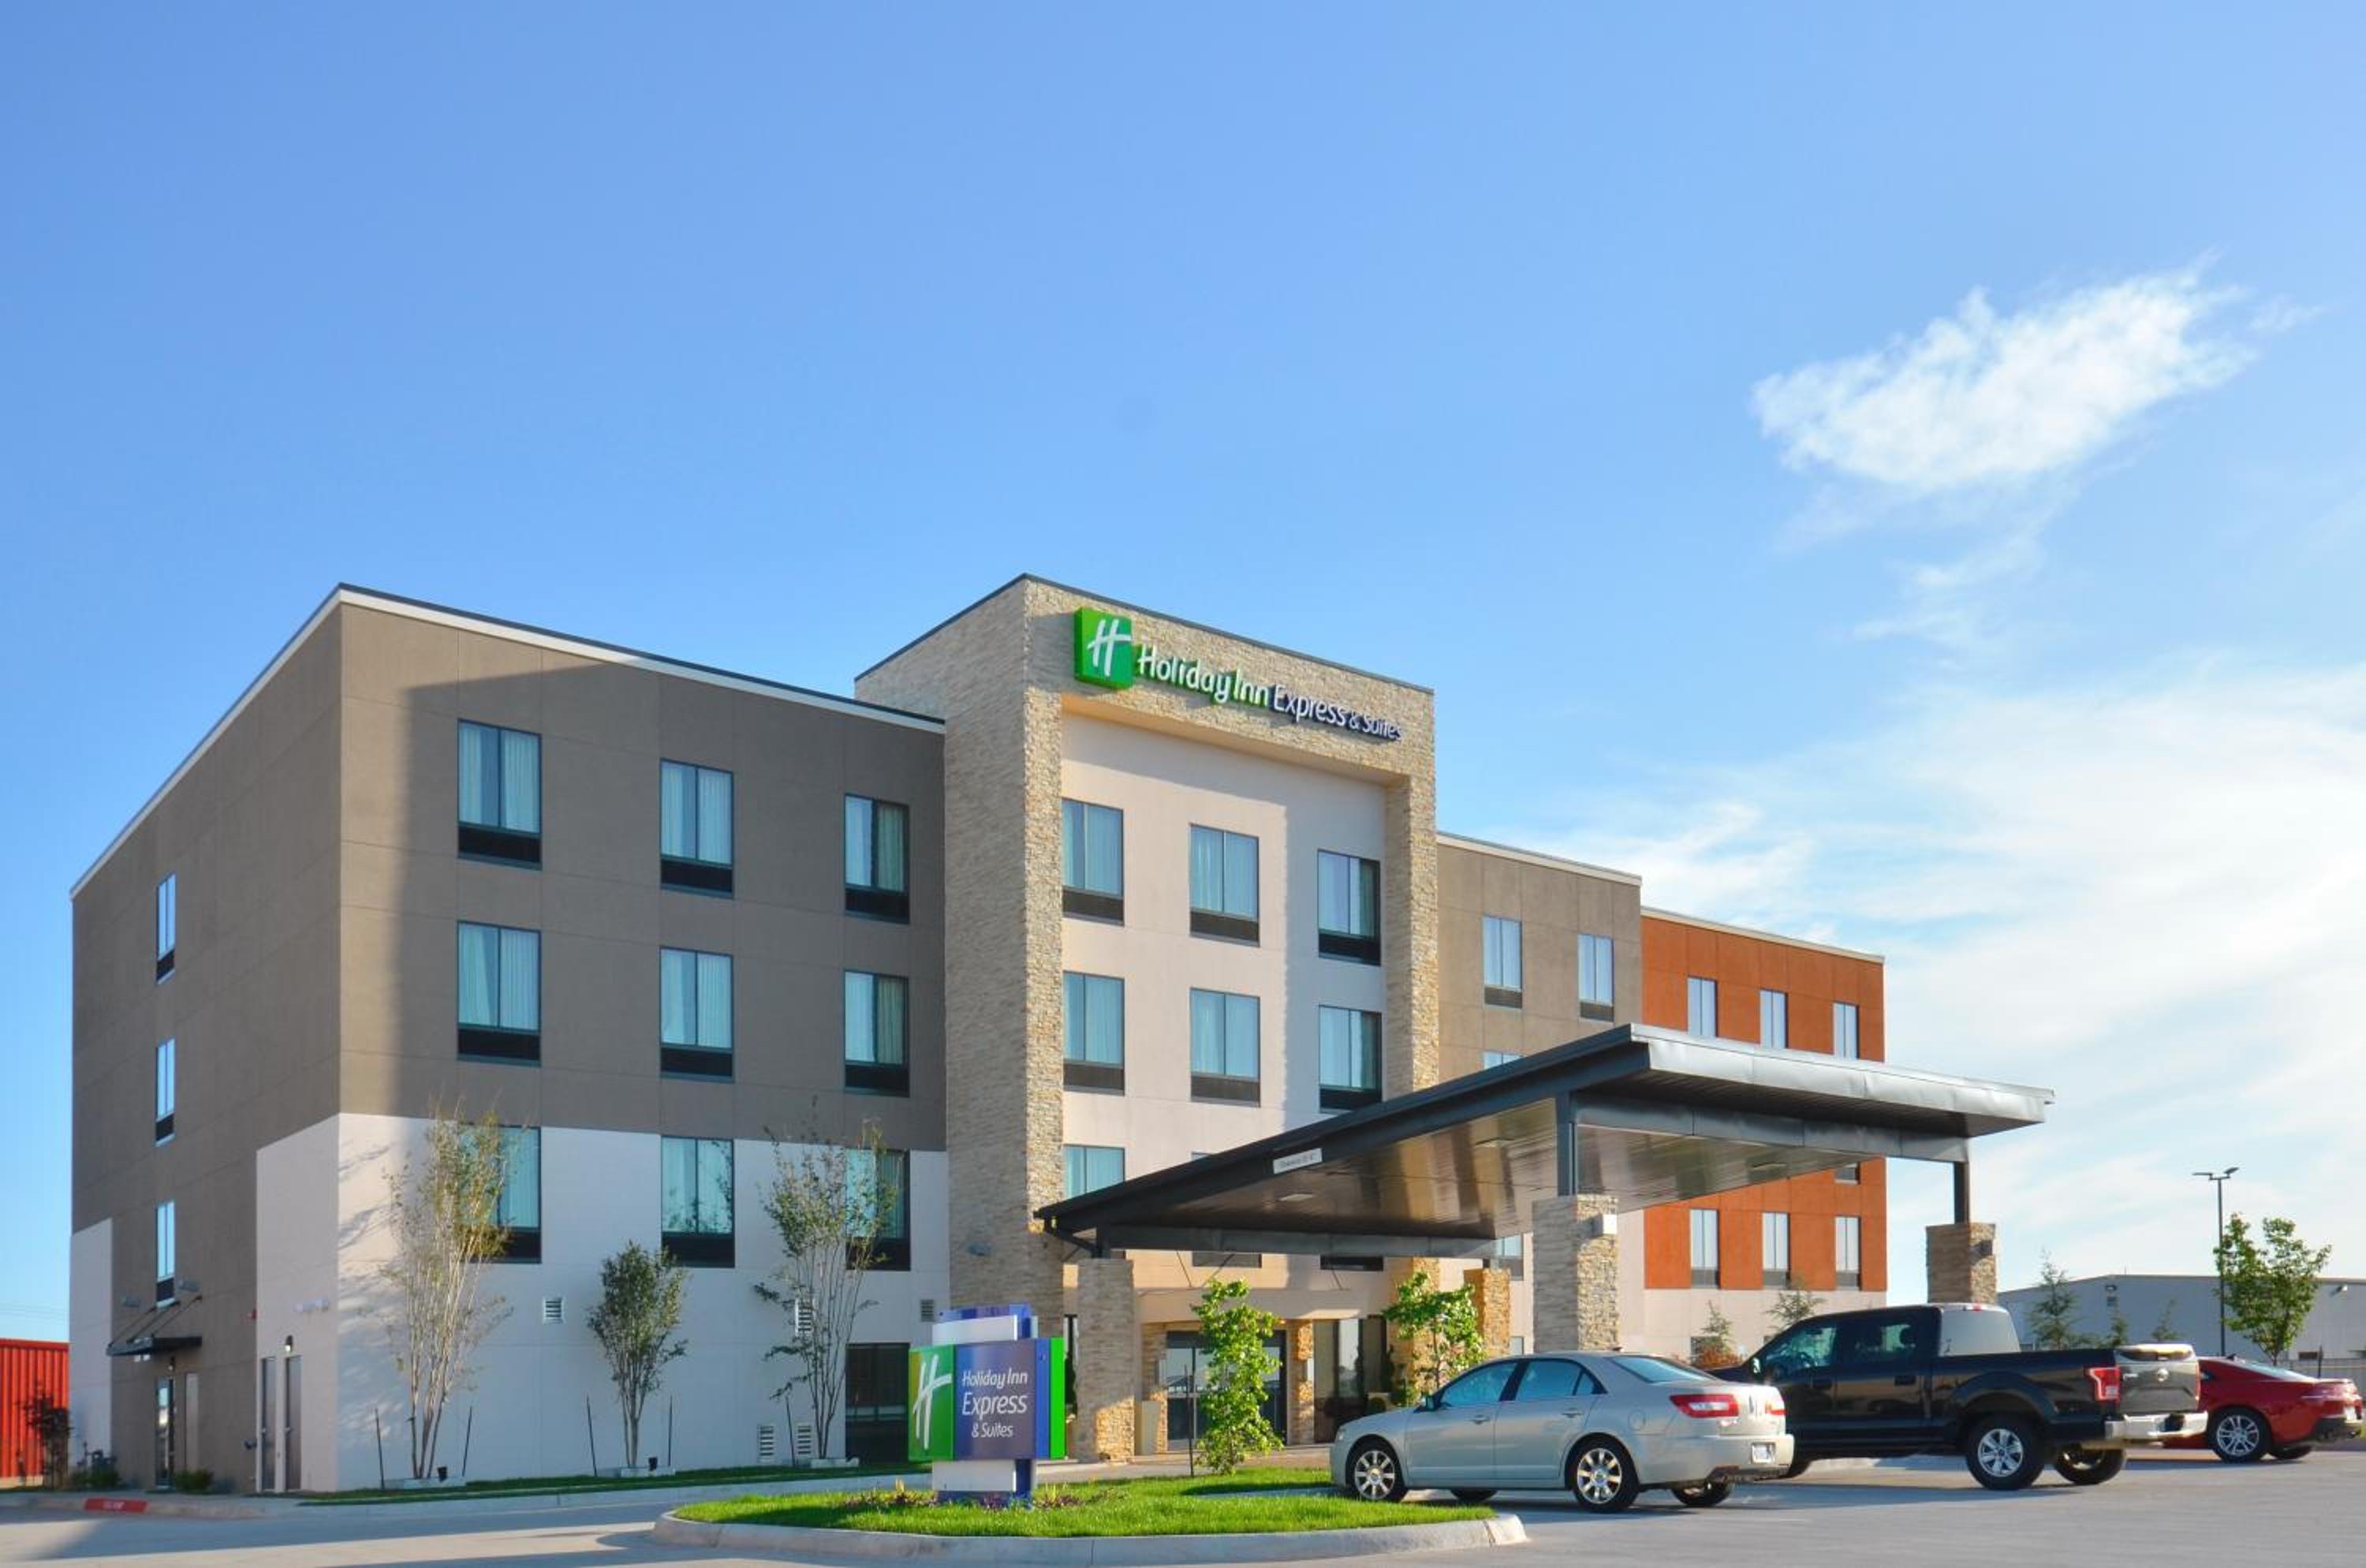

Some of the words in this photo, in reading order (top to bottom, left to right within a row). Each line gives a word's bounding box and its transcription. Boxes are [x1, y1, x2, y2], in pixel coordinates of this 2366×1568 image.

[1137, 643, 1231, 704] Holiday
[1233, 668, 1268, 707] Inn
[1274, 683, 1346, 726] Express
[1349, 712, 1360, 730] &
[1363, 714, 1401, 740] Suites
[961, 1368, 1006, 1389] Holiday
[1007, 1367, 1028, 1384] Inn
[962, 1392, 1028, 1421] Express
[971, 1422, 980, 1438] &
[981, 1422, 1013, 1438] Suites
